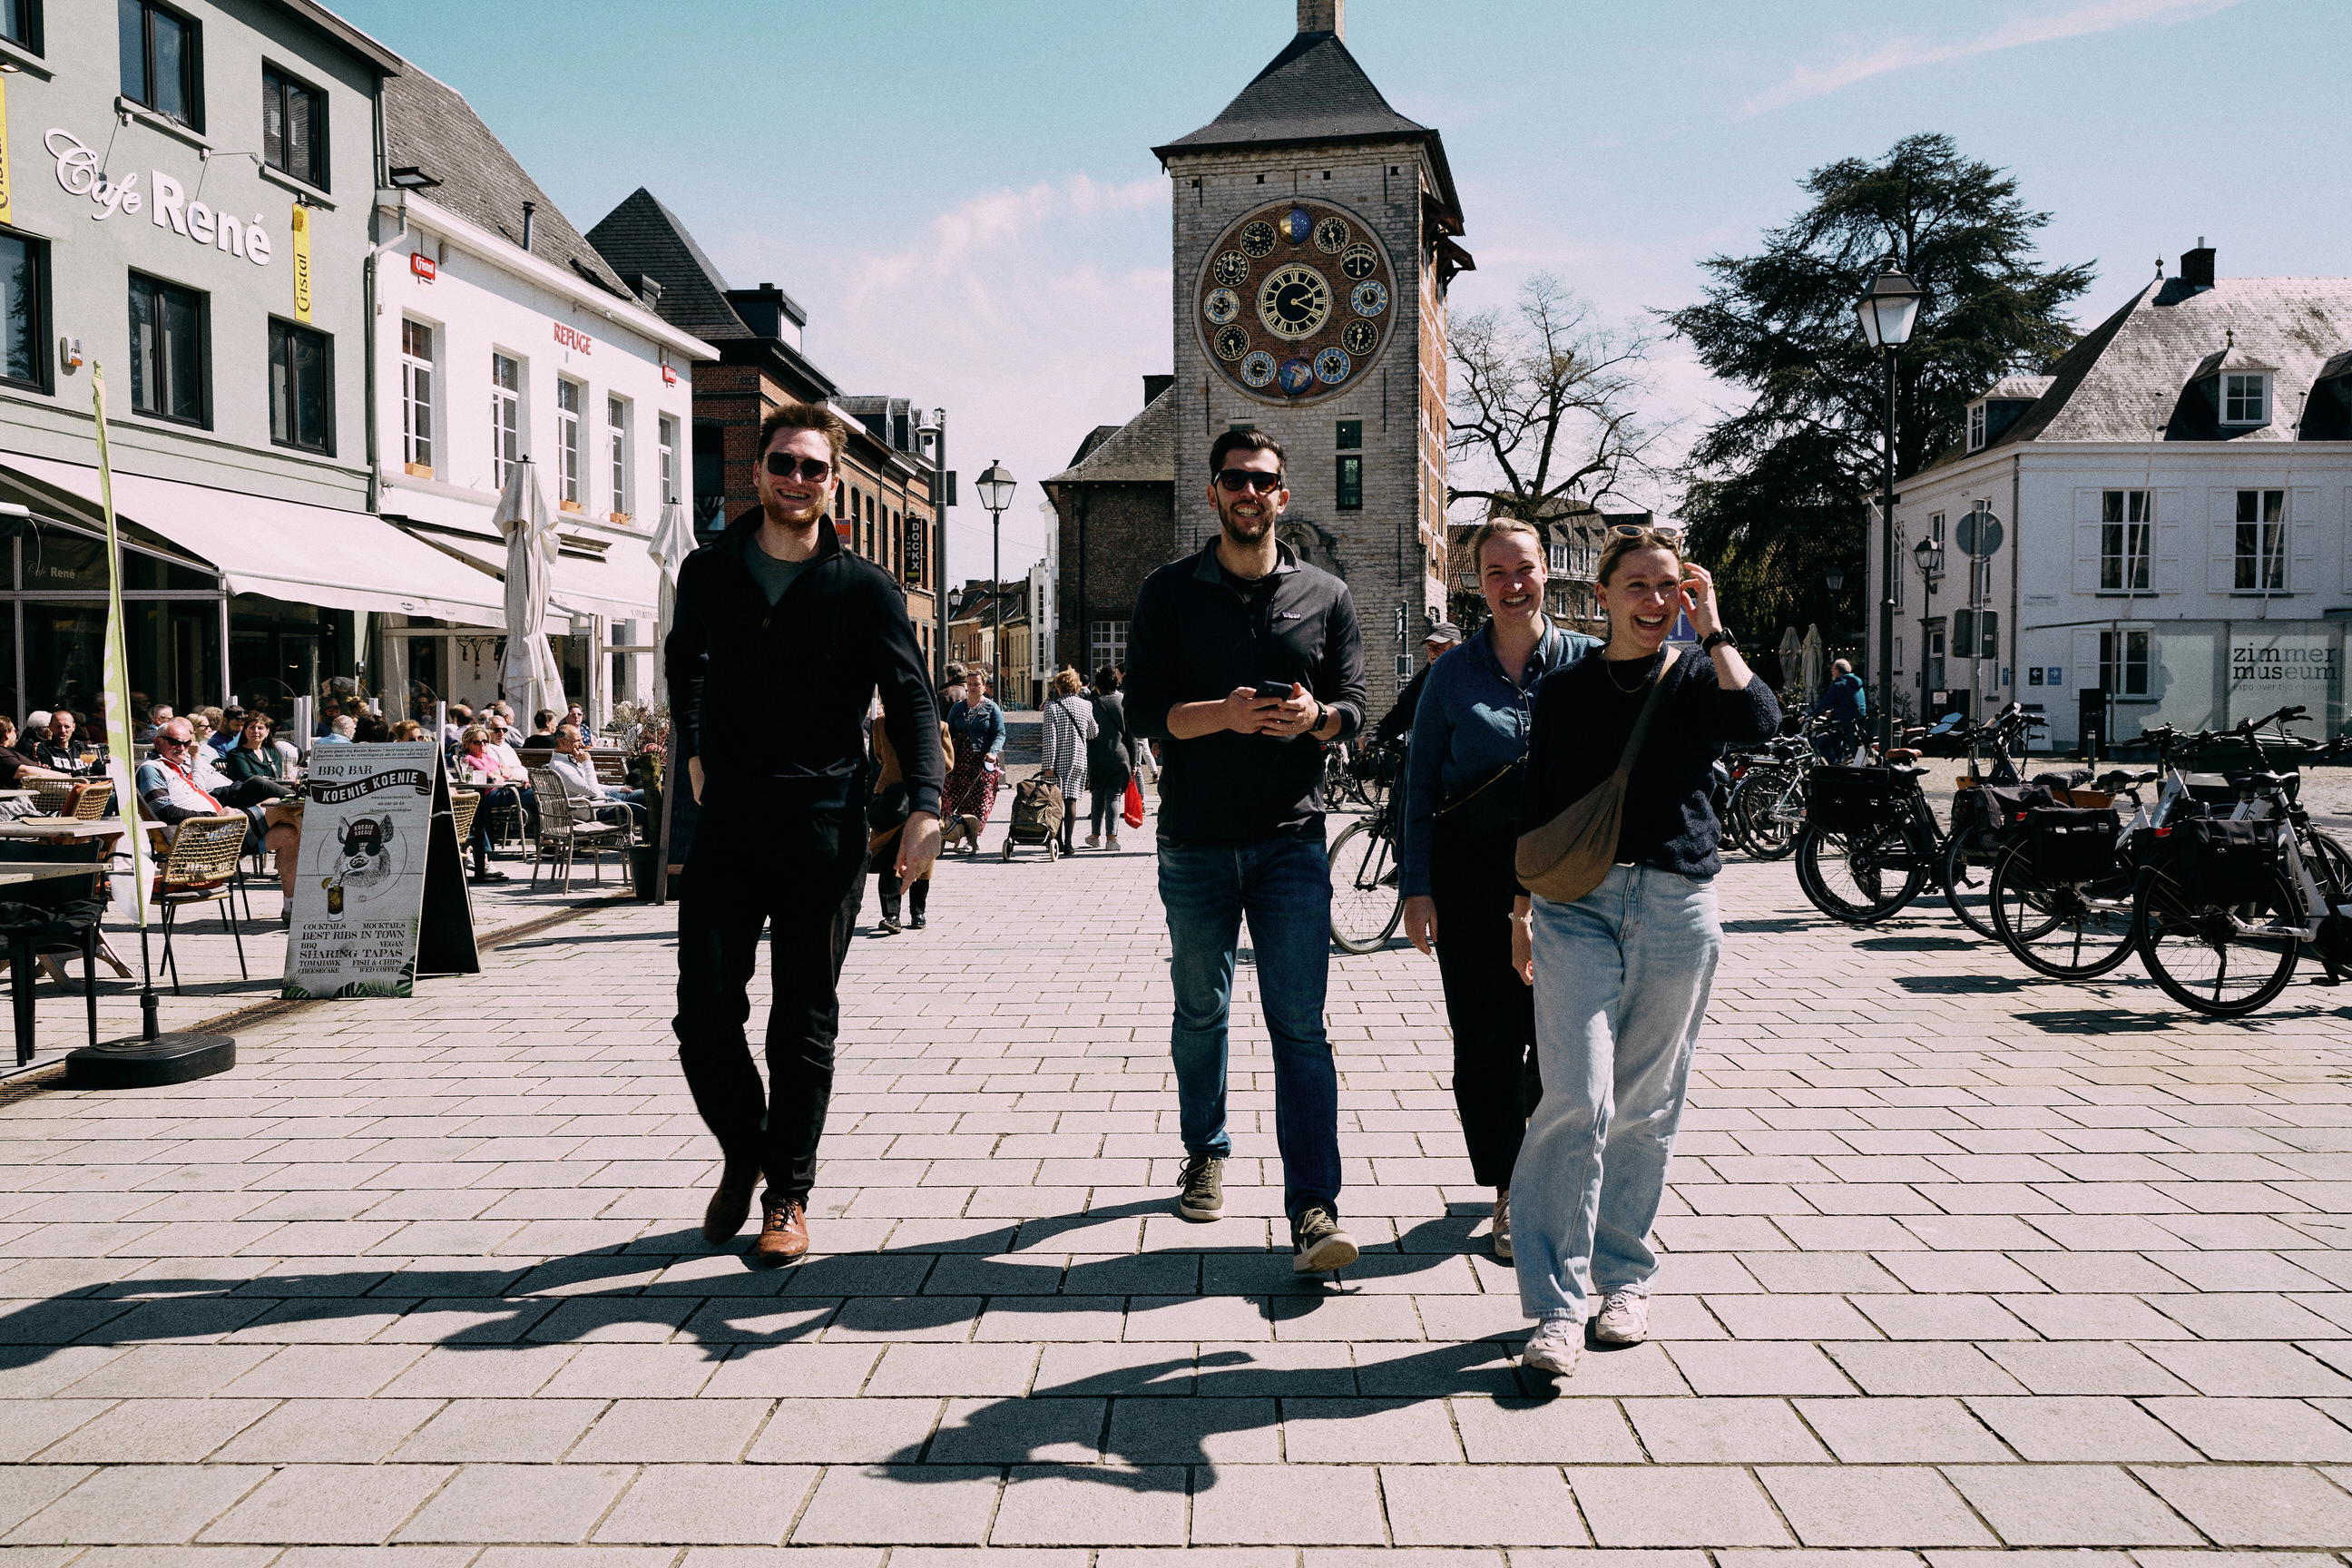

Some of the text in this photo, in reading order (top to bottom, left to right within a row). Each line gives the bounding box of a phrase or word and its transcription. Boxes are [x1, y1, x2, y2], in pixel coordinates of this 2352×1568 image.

[152, 170, 271, 266] René
[297, 253, 310, 313] Cristal
[554, 322, 592, 356] REFUGE
[911, 523, 919, 570] DOCKX
[51, 566, 75, 579] René
[2233, 642, 2337, 662] zimmer
[2232, 666, 2337, 680] museum
[318, 765, 372, 777] BBQ BAR
[322, 771, 418, 802] KOENIE KOENIE
[302, 930, 406, 941] BEST RIBS IN TOWN
[299, 948, 403, 959] SHARING TAPAS
[299, 959, 341, 967] TOMAHAWK
